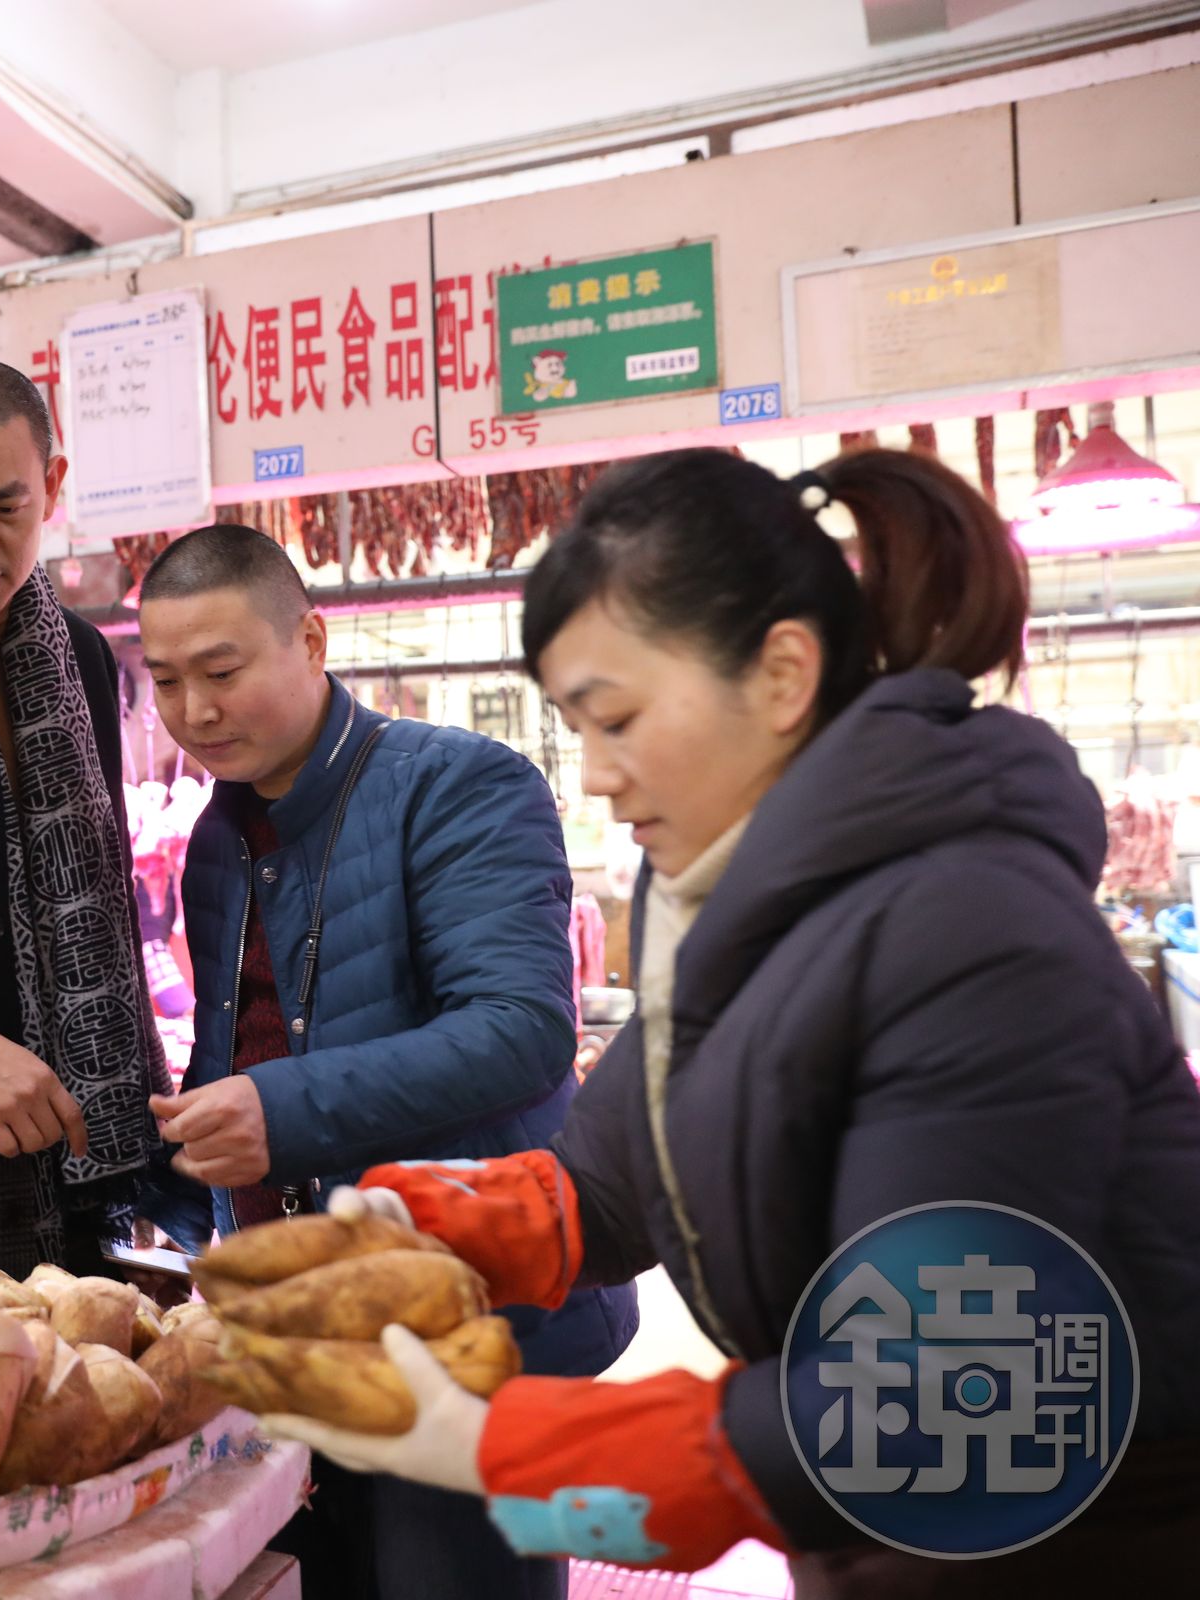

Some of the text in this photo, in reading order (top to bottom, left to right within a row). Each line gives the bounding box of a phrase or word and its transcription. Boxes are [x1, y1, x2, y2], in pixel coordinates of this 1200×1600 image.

[723, 390, 777, 418] 2078
[412, 424, 437, 457] G
[257, 453, 301, 477] 2077
